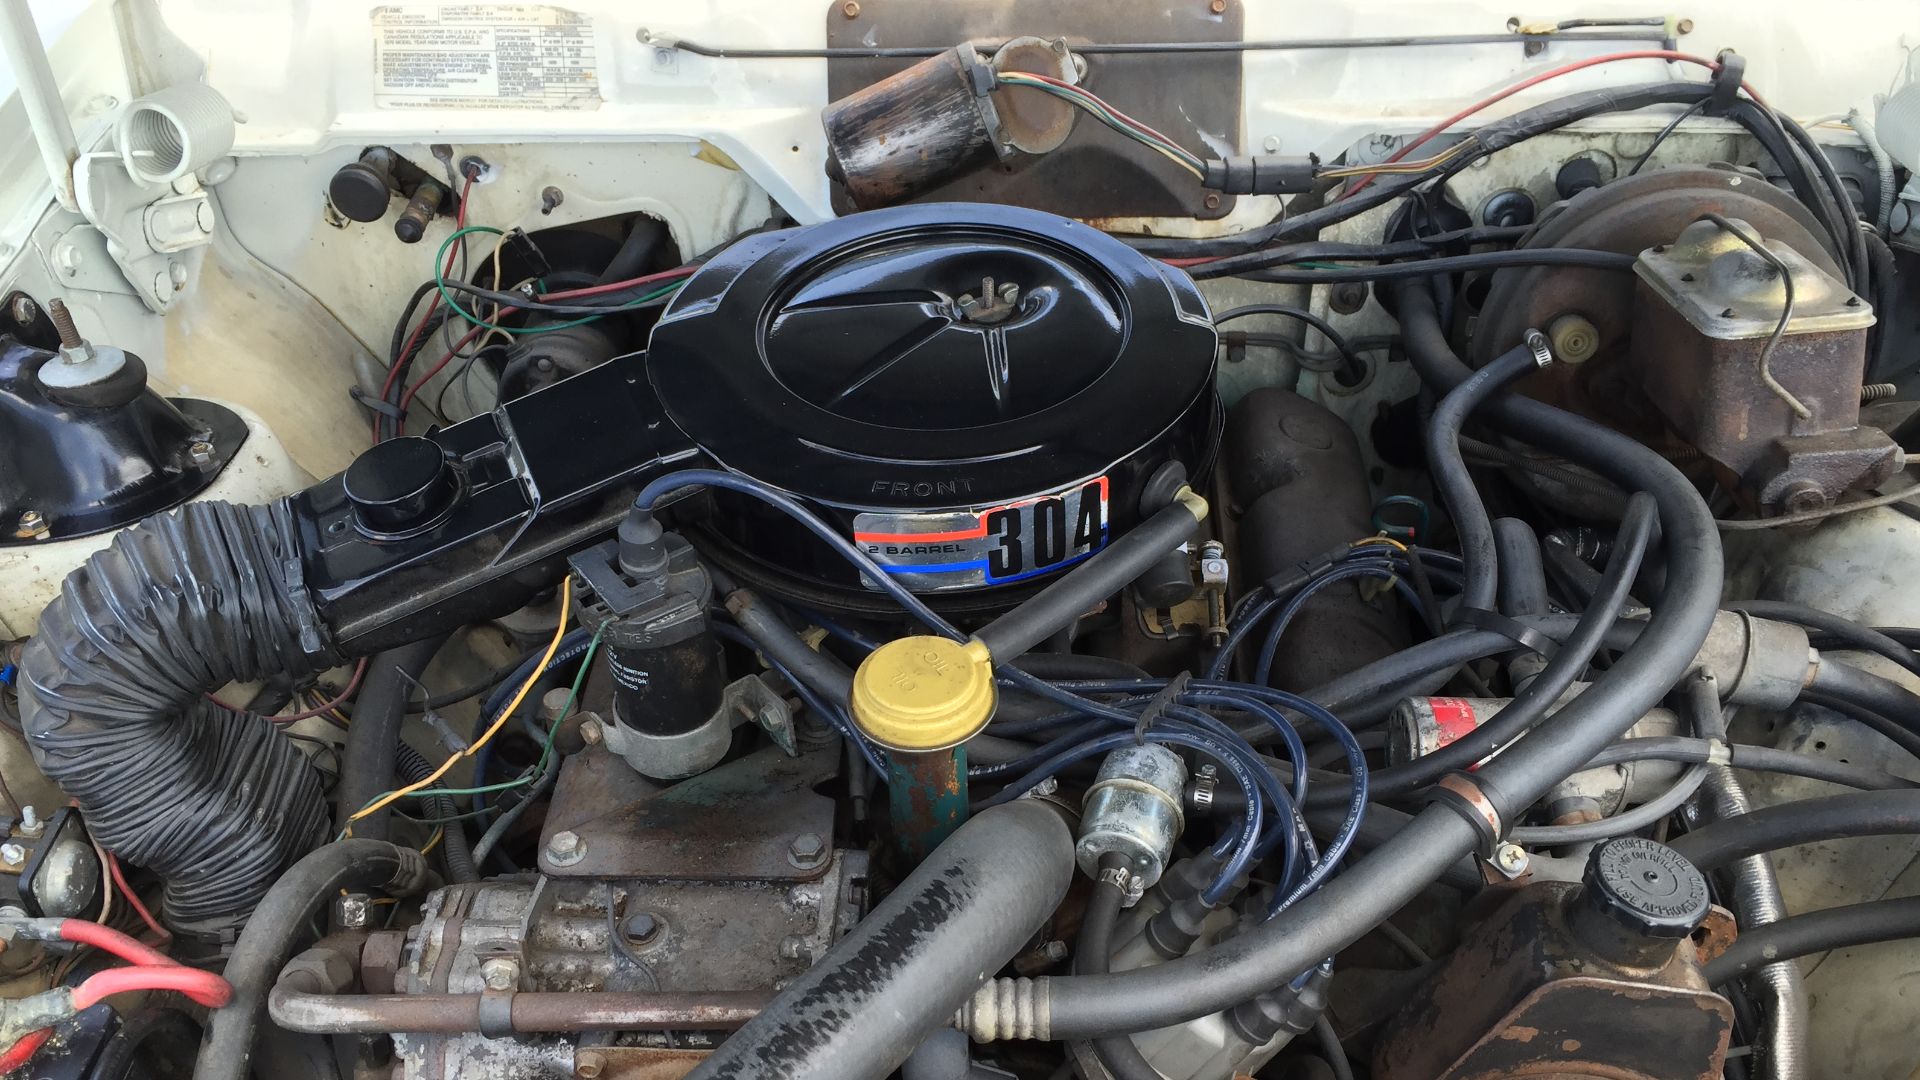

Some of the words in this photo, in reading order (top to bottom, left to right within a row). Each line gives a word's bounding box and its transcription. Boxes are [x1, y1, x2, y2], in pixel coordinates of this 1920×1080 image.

[872, 478, 976, 497] FRONT
[986, 481, 1103, 578] 304
[868, 545, 879, 554] 2
[886, 544, 966, 555] BARREL
[623, 665, 649, 677] IGNITION
[924, 651, 949, 677] OIL
[1241, 775, 1251, 791] SAE
[1278, 884, 1307, 912] Premium
[1308, 864, 1325, 882] 7mm
[1324, 842, 1341, 862] Cable
[1345, 816, 1356, 832] SAE
[1352, 794, 1362, 813] Class
[1602, 847, 1617, 861] TO
[1612, 839, 1655, 852] PROPER
[1658, 846, 1692, 873] LEVEL
[1616, 886, 1639, 905] USE
[1641, 900, 1699, 917] APPROVED
